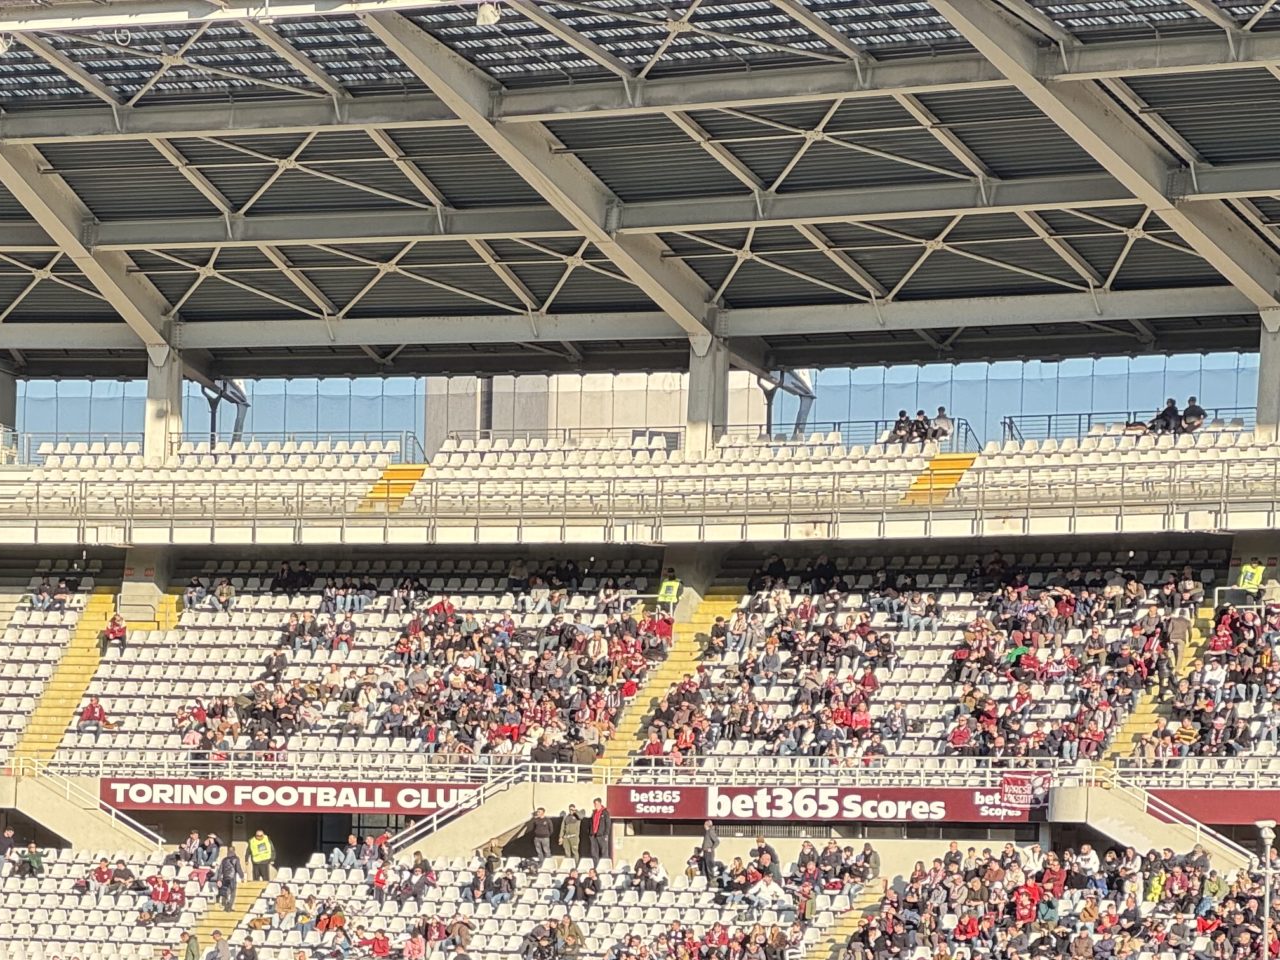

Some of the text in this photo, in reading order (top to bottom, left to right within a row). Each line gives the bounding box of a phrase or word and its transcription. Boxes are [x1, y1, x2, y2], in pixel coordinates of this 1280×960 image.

[111, 783, 478, 809] TORINO FOOTBALL CLUB
[630, 789, 681, 802] bet365
[708, 787, 946, 819] bet365 Scores
[636, 803, 675, 814] Scores
